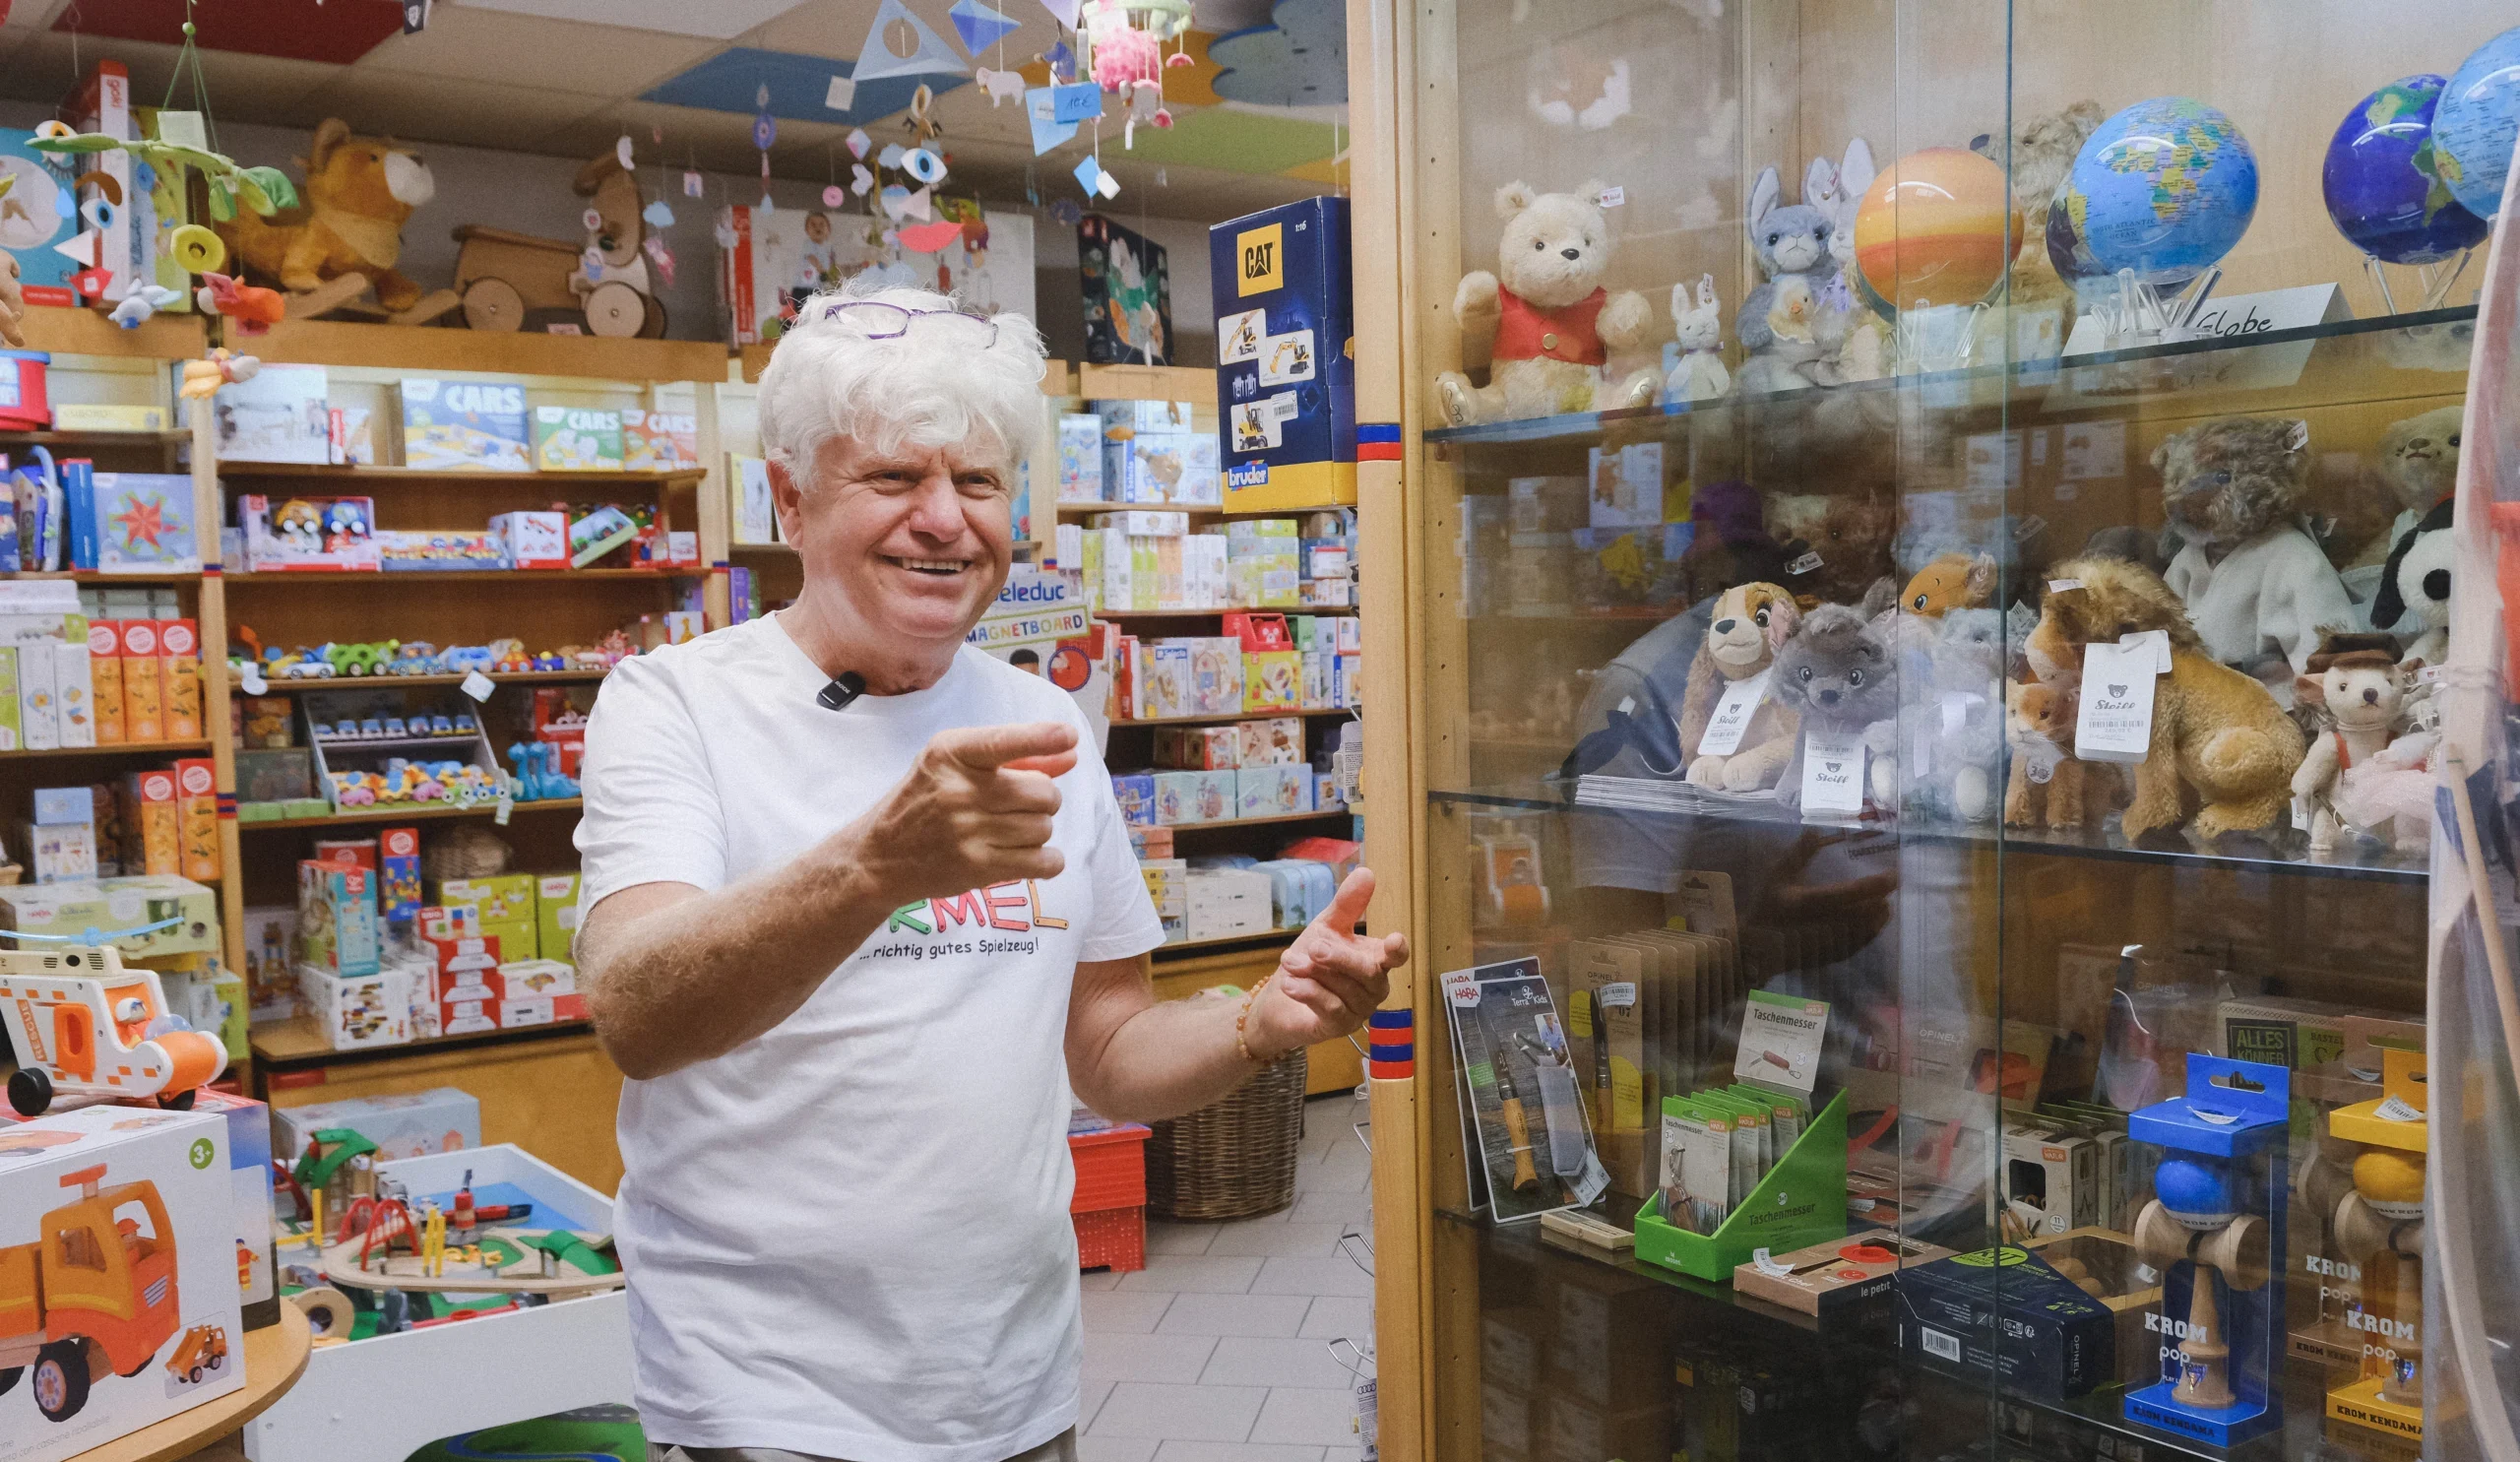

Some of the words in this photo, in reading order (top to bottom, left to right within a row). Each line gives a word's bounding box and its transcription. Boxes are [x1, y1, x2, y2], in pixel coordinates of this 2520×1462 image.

[1295, 220, 1307, 232] 1:16
[2114, 218, 2157, 229] ATLANTIC
[1244, 241, 1274, 280] CAT
[2196, 305, 2273, 337] Globe
[445, 385, 524, 413] CARS
[567, 411, 620, 431] CARS
[647, 413, 697, 433] CARS
[1228, 467, 1267, 487] bruder
[994, 581, 1065, 603] eleduc
[966, 614, 1083, 643] MAGNETBOARD
[1816, 773, 1849, 784] Steiff
[929, 940, 973, 959] gutes
[978, 936, 1040, 958] Spielzeug!
[1455, 986, 1480, 1000] HABA
[1511, 997, 1531, 1007] Terra
[1533, 994, 1548, 1004] Kids
[1753, 1008, 1818, 1030] Taschenmesser
[1920, 1029, 1957, 1043] OPINEL
[2236, 1031, 2284, 1049] ALLES
[1665, 1118, 1704, 1135] Taschenmesser
[193, 1145, 212, 1164] 3+
[1749, 1203, 1816, 1227] Taschenmesser
[1860, 1286, 1868, 1298] le
[1870, 1281, 1891, 1297] petit
[2319, 1286, 2352, 1304] pop
[2144, 1311, 2208, 1343] KROM
[2347, 1309, 2416, 1342] KROM
[2159, 1346, 2191, 1367] pop
[2296, 1341, 2324, 1357] KROM
[2362, 1343, 2397, 1364] pop
[2133, 1405, 2160, 1422] KROM
[2163, 1414, 2215, 1438] KENDAMA
[2336, 1404, 2366, 1421] KROM
[36, 1430, 70, 1450] cassone
